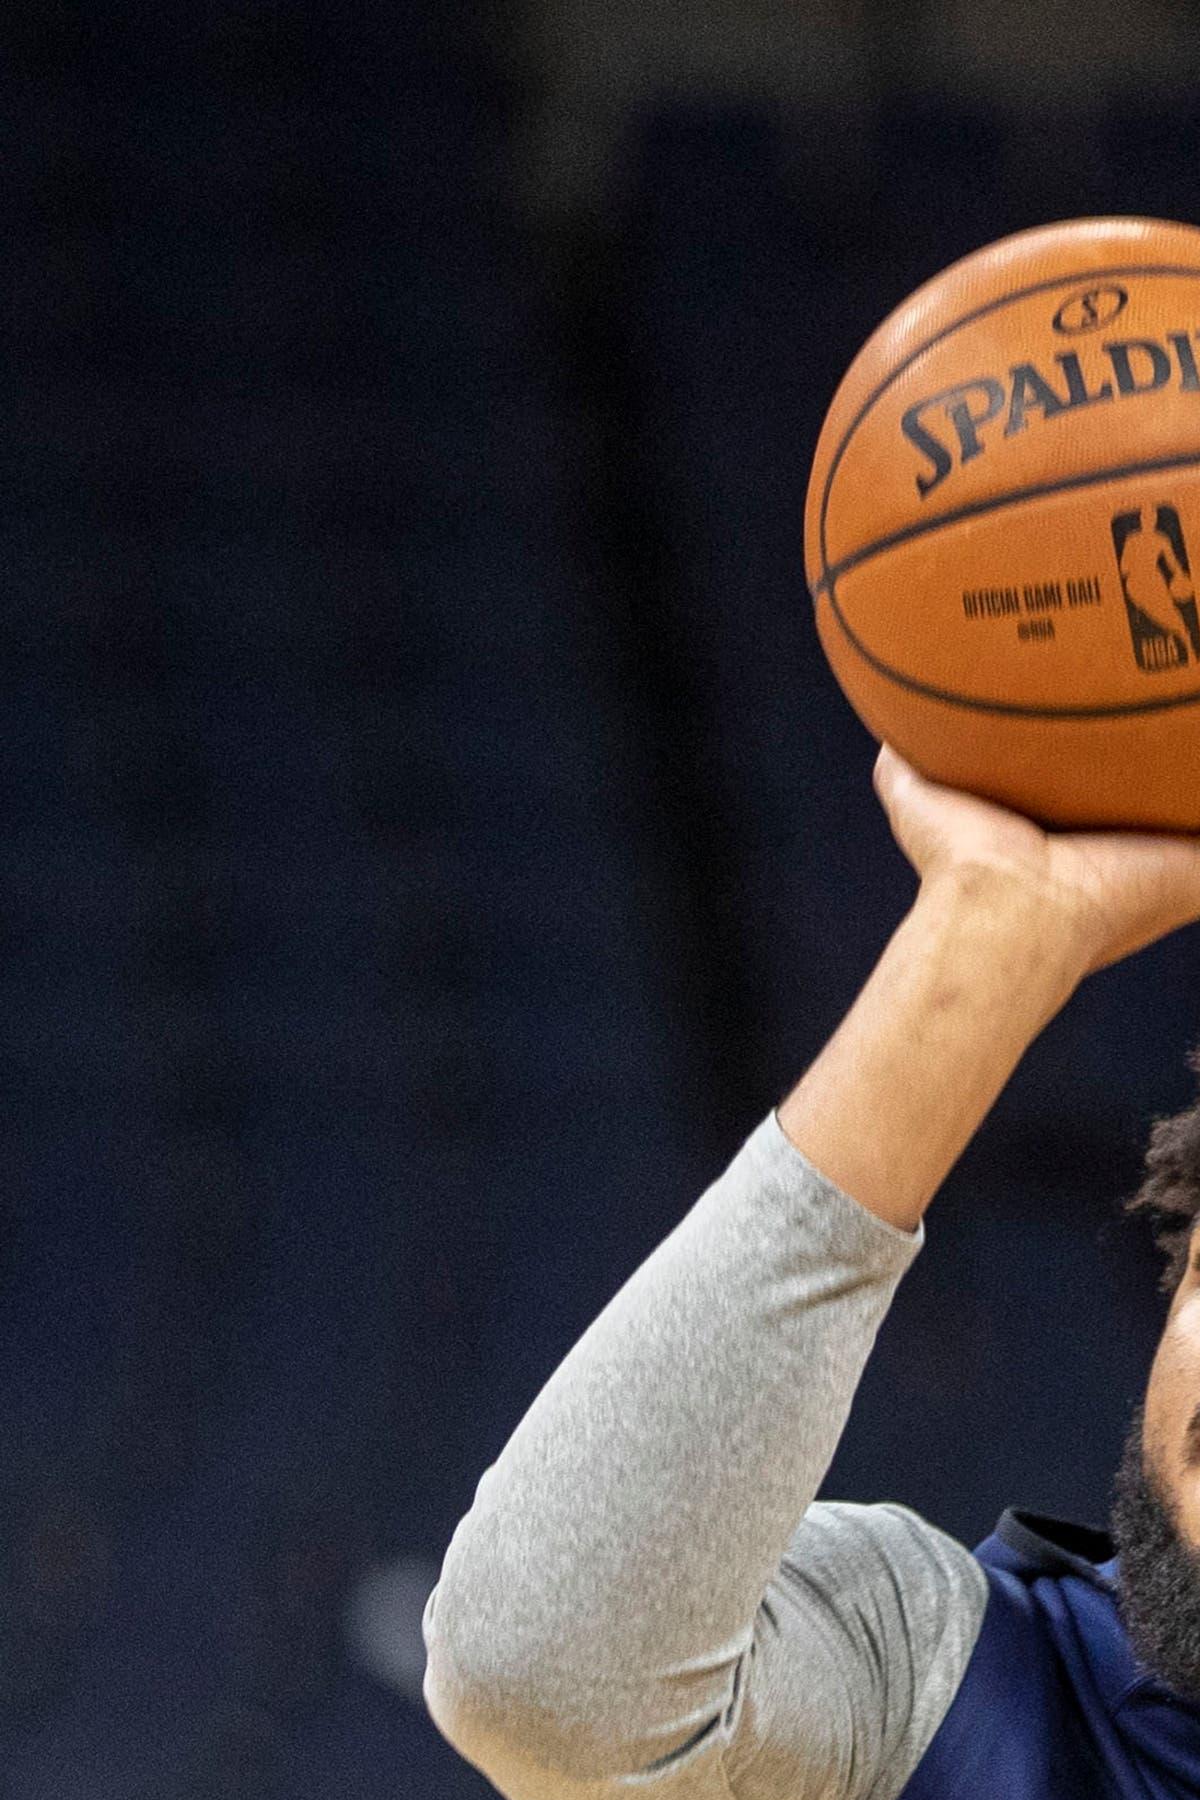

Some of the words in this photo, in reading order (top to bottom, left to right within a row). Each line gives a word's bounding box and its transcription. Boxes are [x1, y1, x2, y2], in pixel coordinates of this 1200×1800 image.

[963, 587, 1020, 619] OFFICIAL
[1023, 580, 1062, 613] GAME
[1067, 575, 1100, 609] BALL
[1141, 634, 1180, 671] NBA
